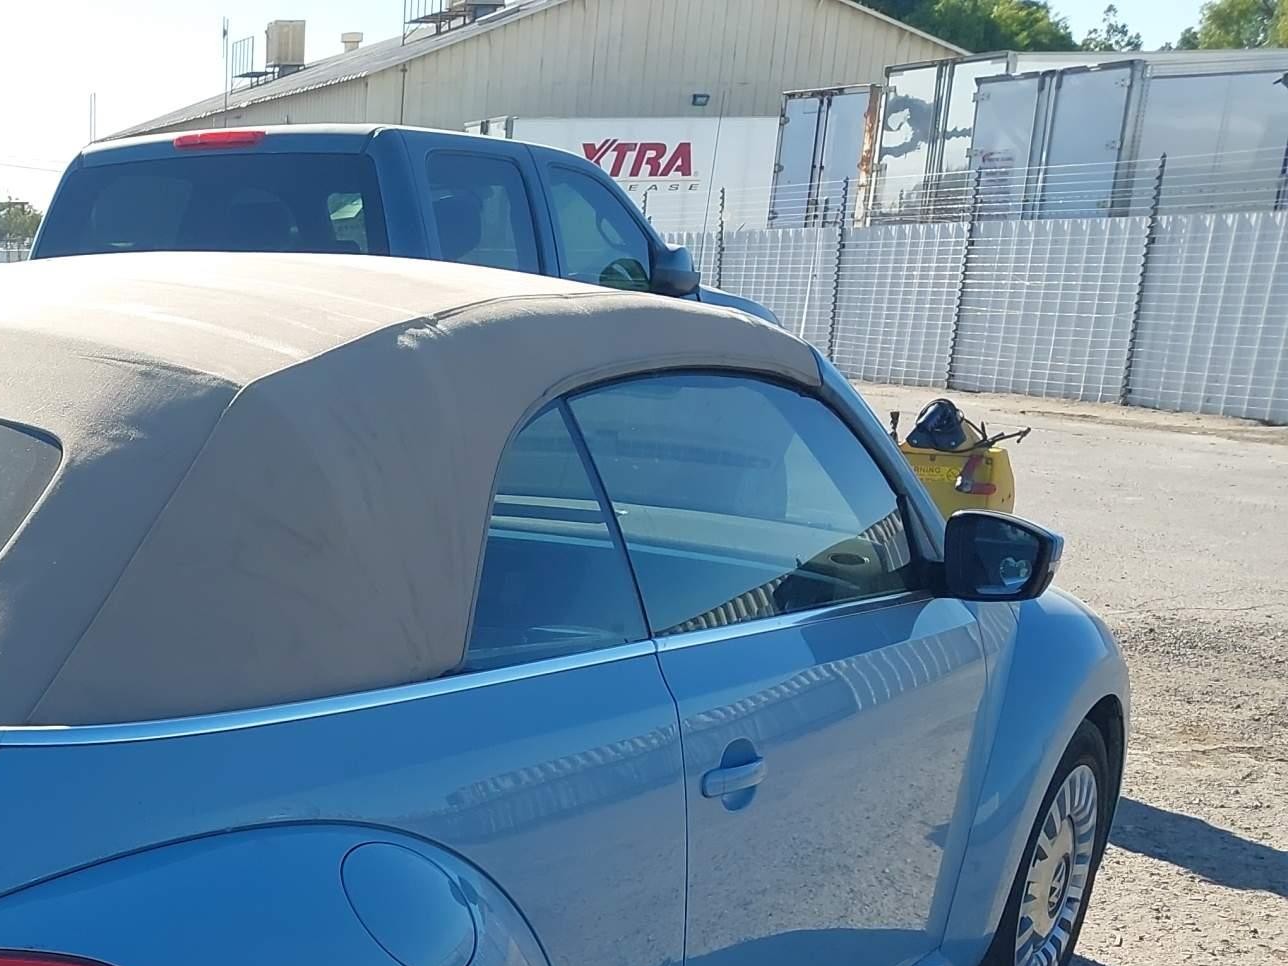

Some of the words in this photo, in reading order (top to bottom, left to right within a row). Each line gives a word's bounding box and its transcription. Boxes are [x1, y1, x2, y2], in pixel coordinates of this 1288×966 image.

[582, 139, 692, 177] XTRA
[628, 183, 700, 192] EASE
[913, 465, 941, 474] RNING
